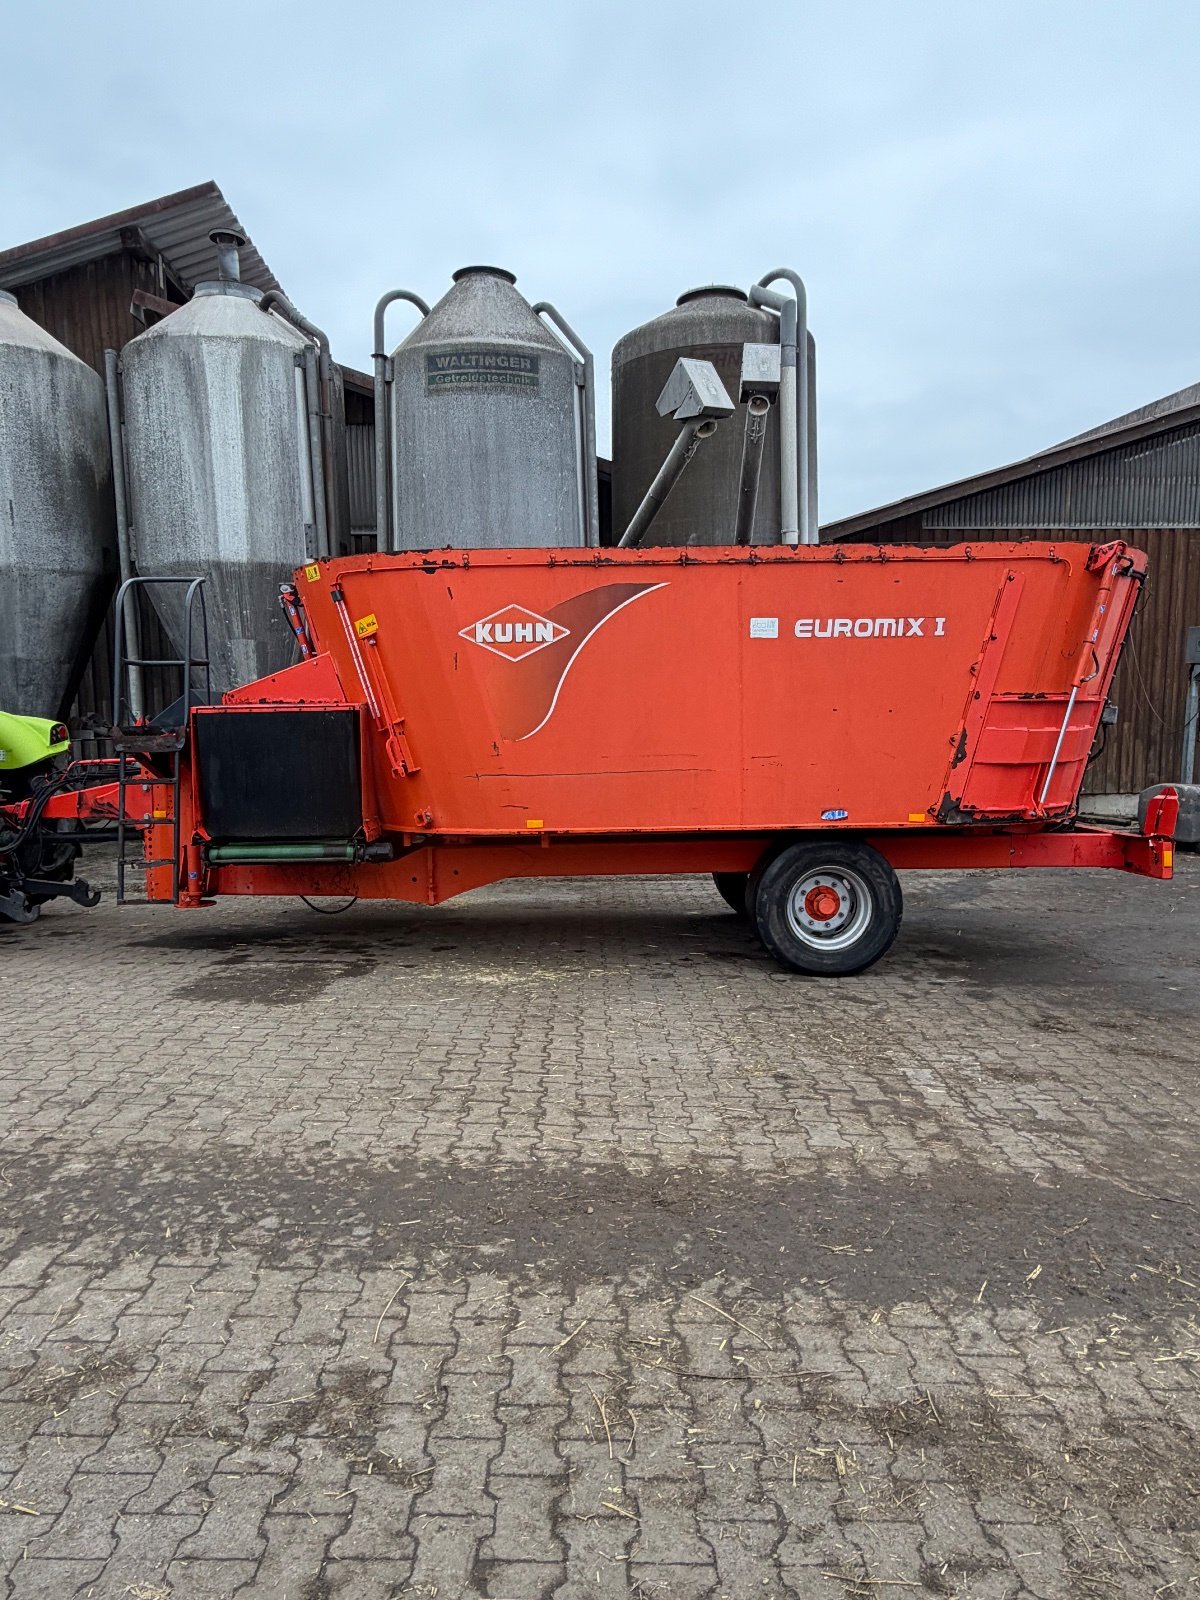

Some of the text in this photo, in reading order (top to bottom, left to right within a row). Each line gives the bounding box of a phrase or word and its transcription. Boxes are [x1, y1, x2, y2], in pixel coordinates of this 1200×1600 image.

[436, 355, 531, 369] WALTINGER
[475, 623, 554, 643] KUHN
[795, 617, 926, 638] EUROMIX
[933, 617, 947, 636] I
